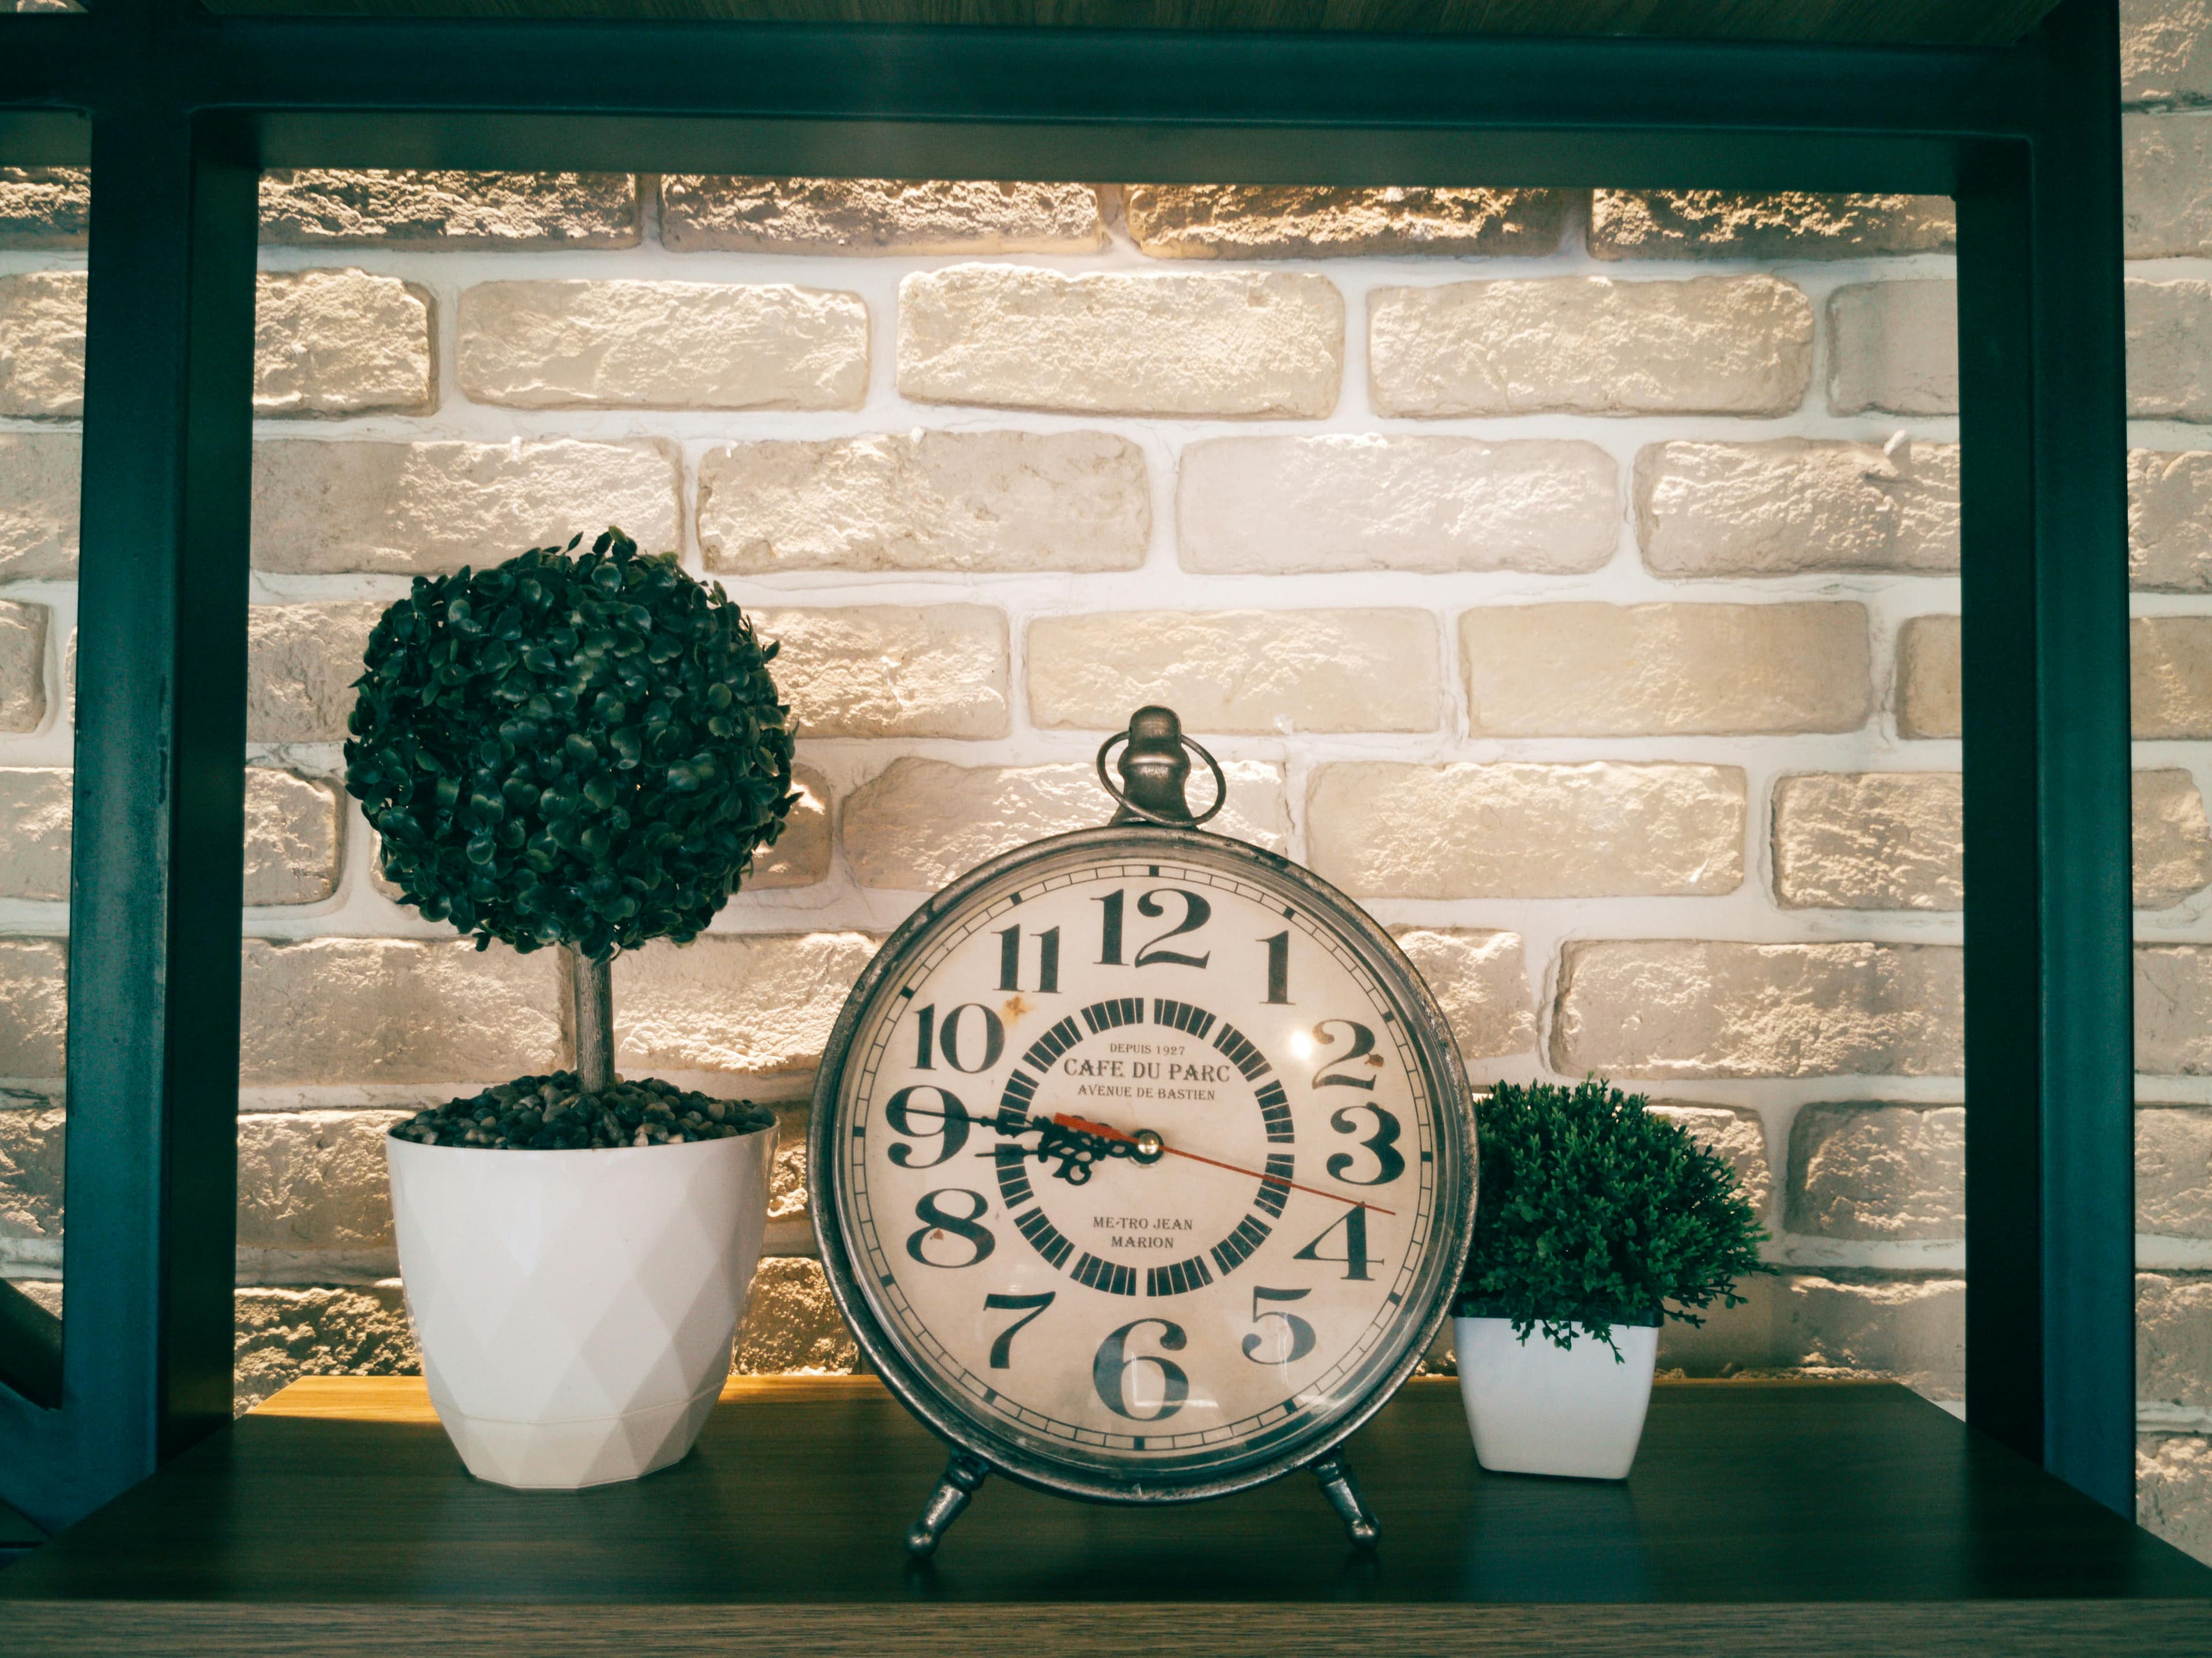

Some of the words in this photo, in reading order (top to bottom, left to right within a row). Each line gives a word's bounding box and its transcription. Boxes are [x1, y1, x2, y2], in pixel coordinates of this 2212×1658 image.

[991, 923, 1063, 995] 11
[1090, 888, 1211, 968] 12
[1255, 929, 1296, 1006] 1
[910, 1002, 1006, 1074] 10
[1063, 1058, 1124, 1079] CAFE
[1132, 1061, 1161, 1080] DU
[1168, 1063, 1231, 1082] PARC
[1110, 1043, 1152, 1055] DEPUIS
[1157, 1046, 1185, 1055] 1927
[1311, 1019, 1378, 1091] 2
[885, 1085, 970, 1169] 9
[1078, 1084, 1132, 1097] AVENUE
[1137, 1087, 1154, 1099] DE
[1158, 1088, 1215, 1100] BASTIEN
[1326, 1103, 1406, 1186] 3
[906, 1188, 996, 1268] 8
[1111, 1236, 1174, 1248] MARION
[1153, 1218, 1192, 1231] JEAN
[1292, 1201, 1385, 1281] 4
[983, 1290, 1056, 1369] 7
[1241, 1285, 1317, 1365] 5
[1093, 1318, 1190, 1422] 6
